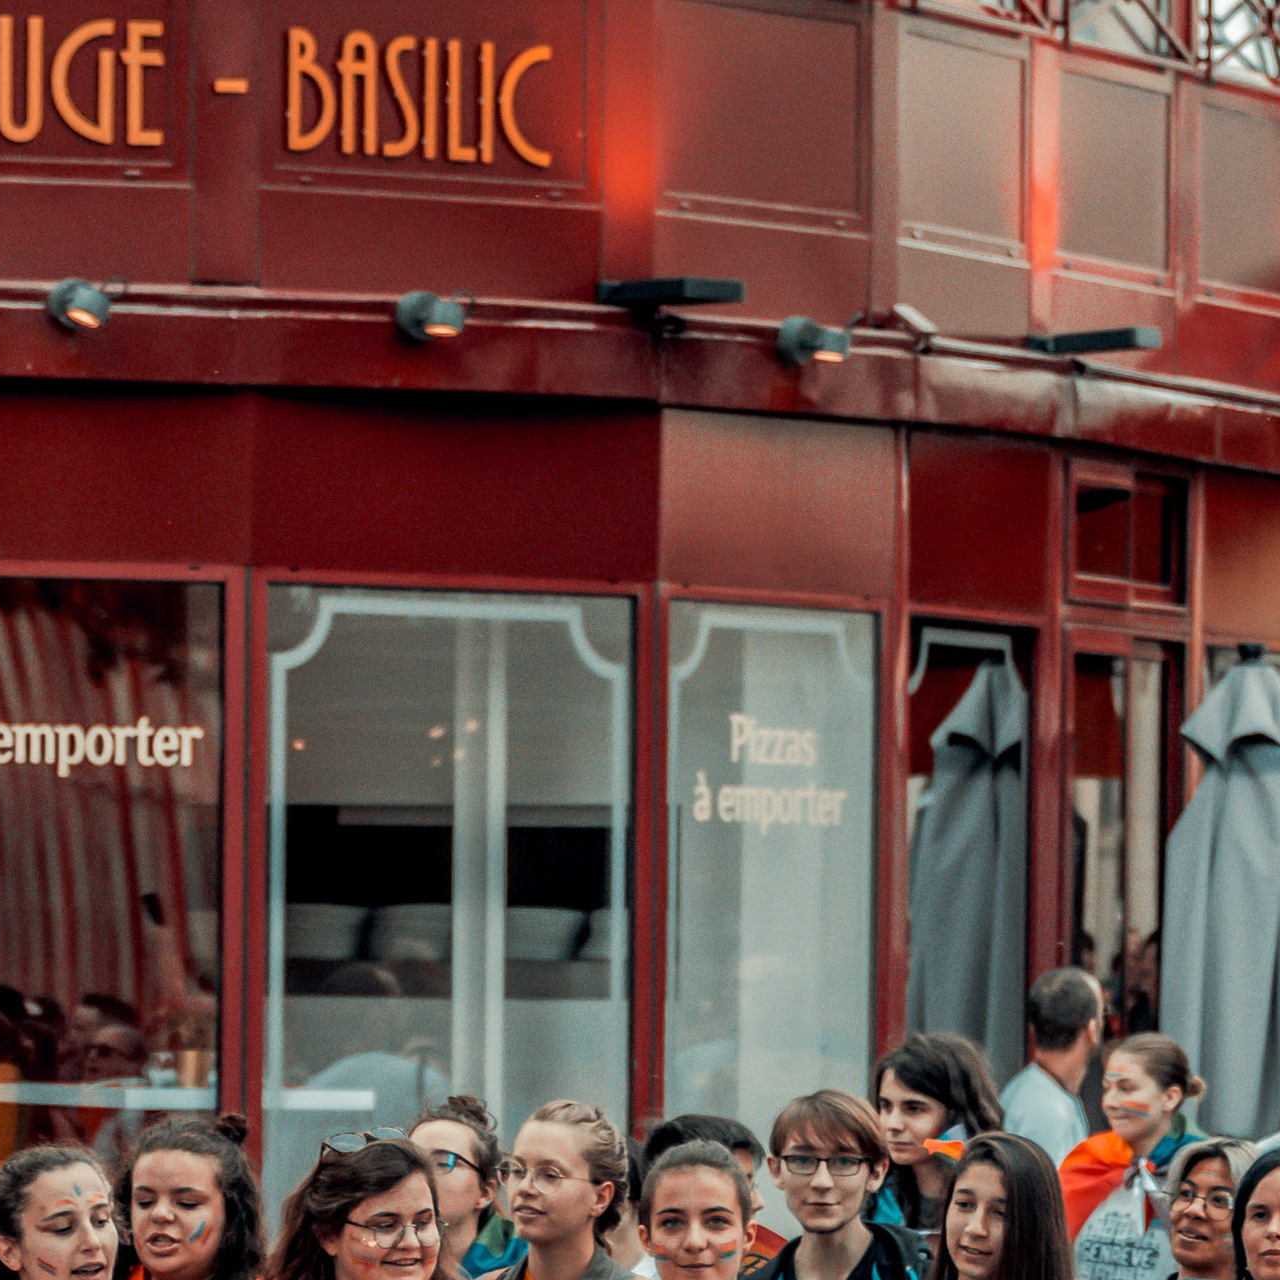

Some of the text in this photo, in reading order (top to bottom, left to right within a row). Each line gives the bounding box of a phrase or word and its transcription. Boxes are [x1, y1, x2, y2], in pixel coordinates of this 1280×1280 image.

[286, 26, 554, 168] BASILIC
[729, 711, 818, 767] Pizzas
[692, 772, 848, 835] à emporter
